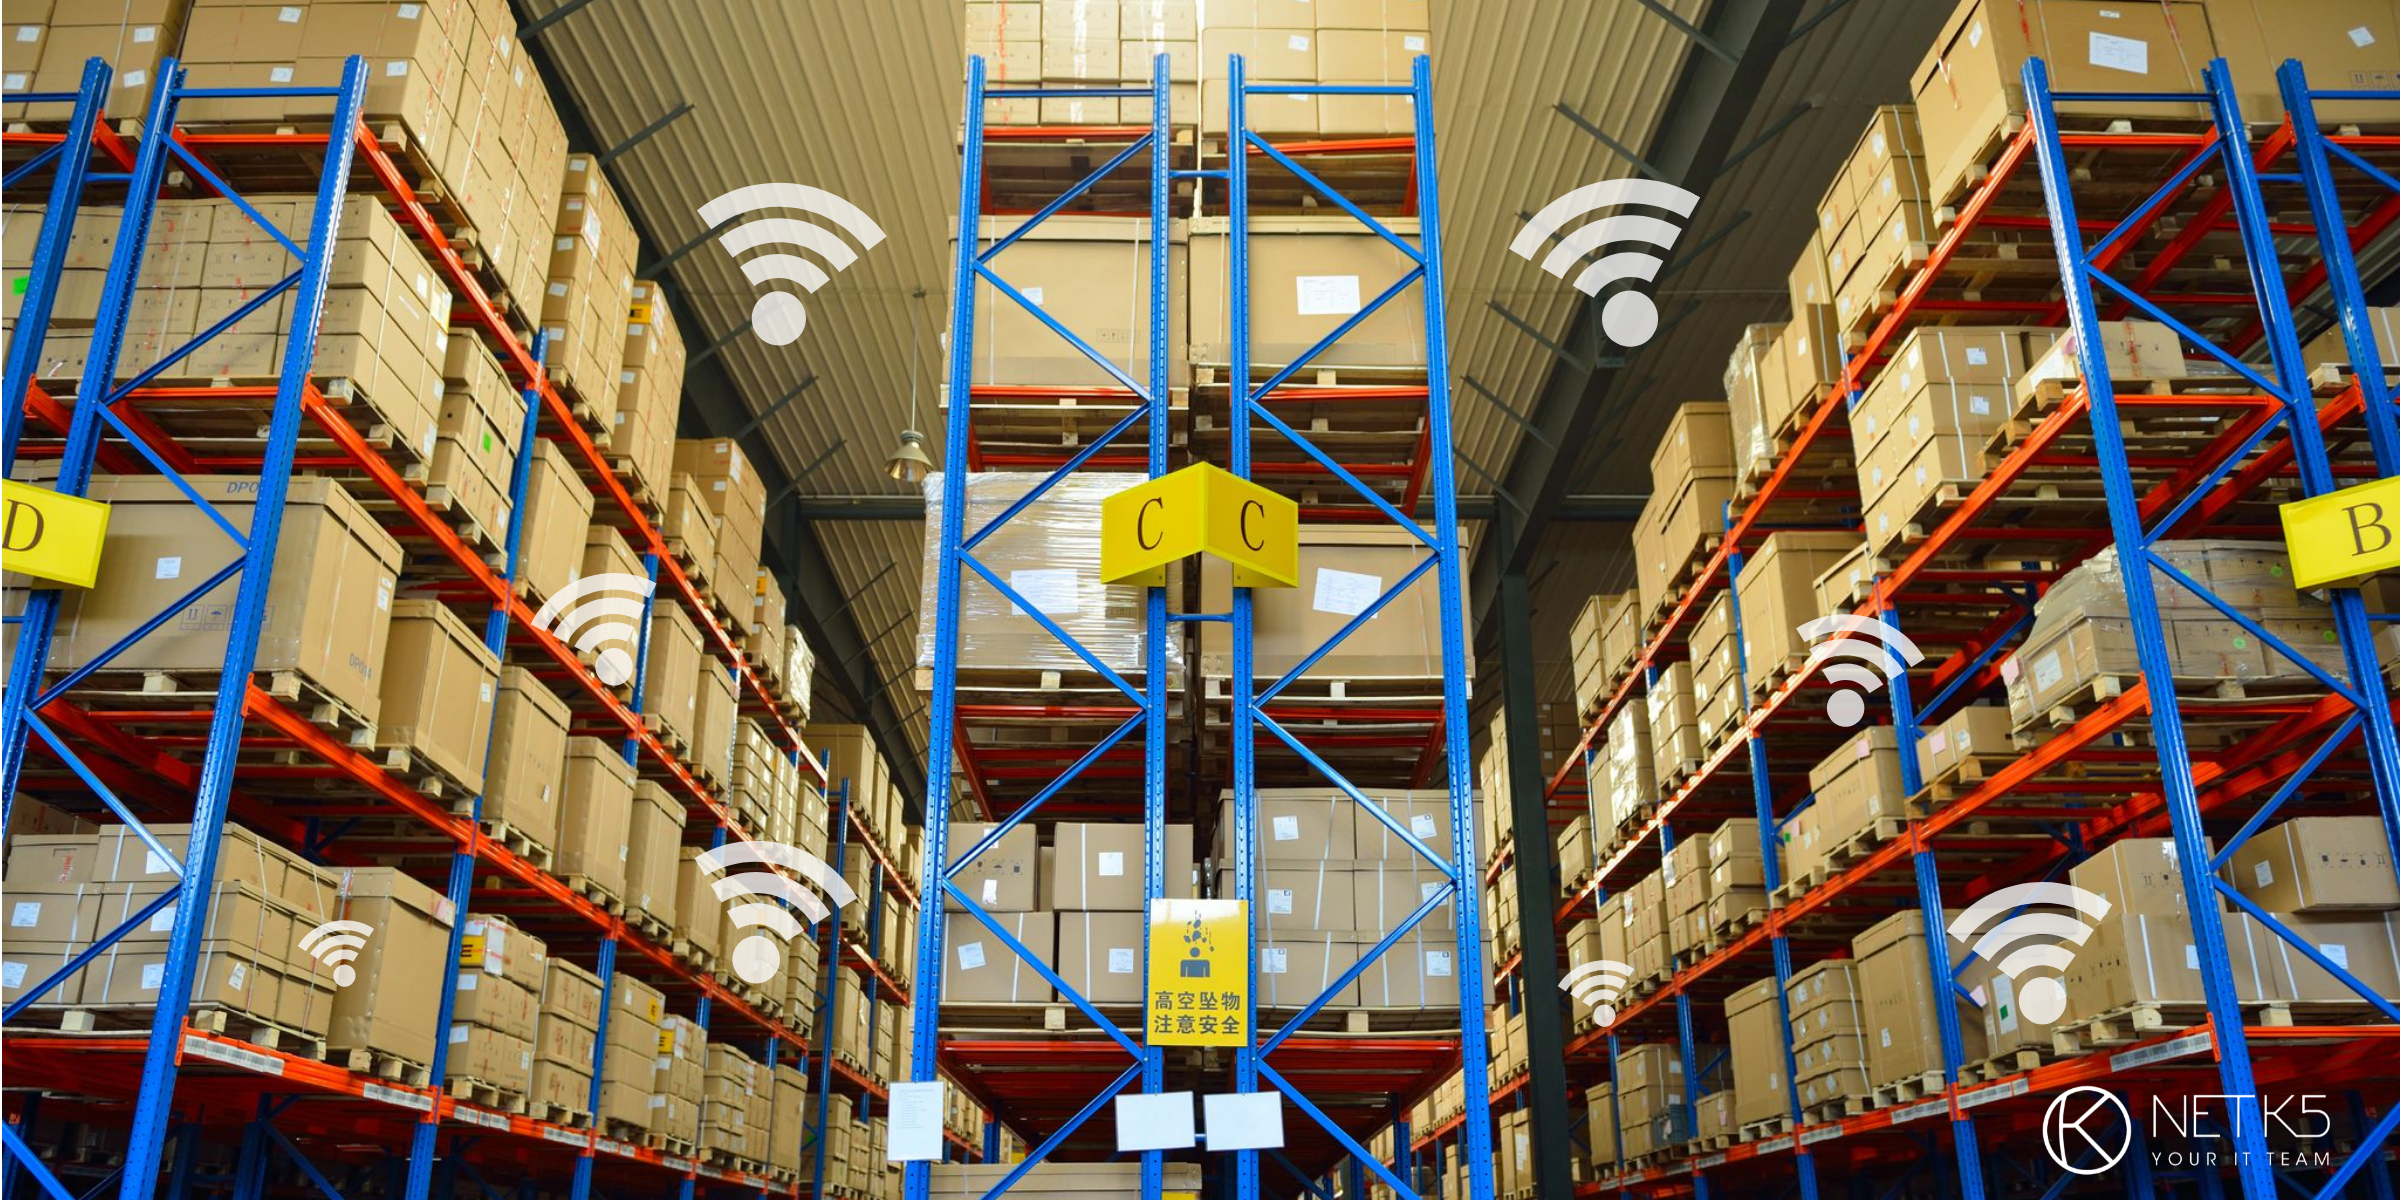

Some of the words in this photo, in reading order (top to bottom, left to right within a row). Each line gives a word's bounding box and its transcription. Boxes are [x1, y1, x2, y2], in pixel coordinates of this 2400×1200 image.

[2, 499, 45, 552] D
[1137, 496, 1164, 551] C
[1240, 499, 1265, 552] C
[2341, 502, 2392, 557] B
[1154, 990, 1241, 1012] 高空坠物
[1154, 1014, 1241, 1035] 注意安全
